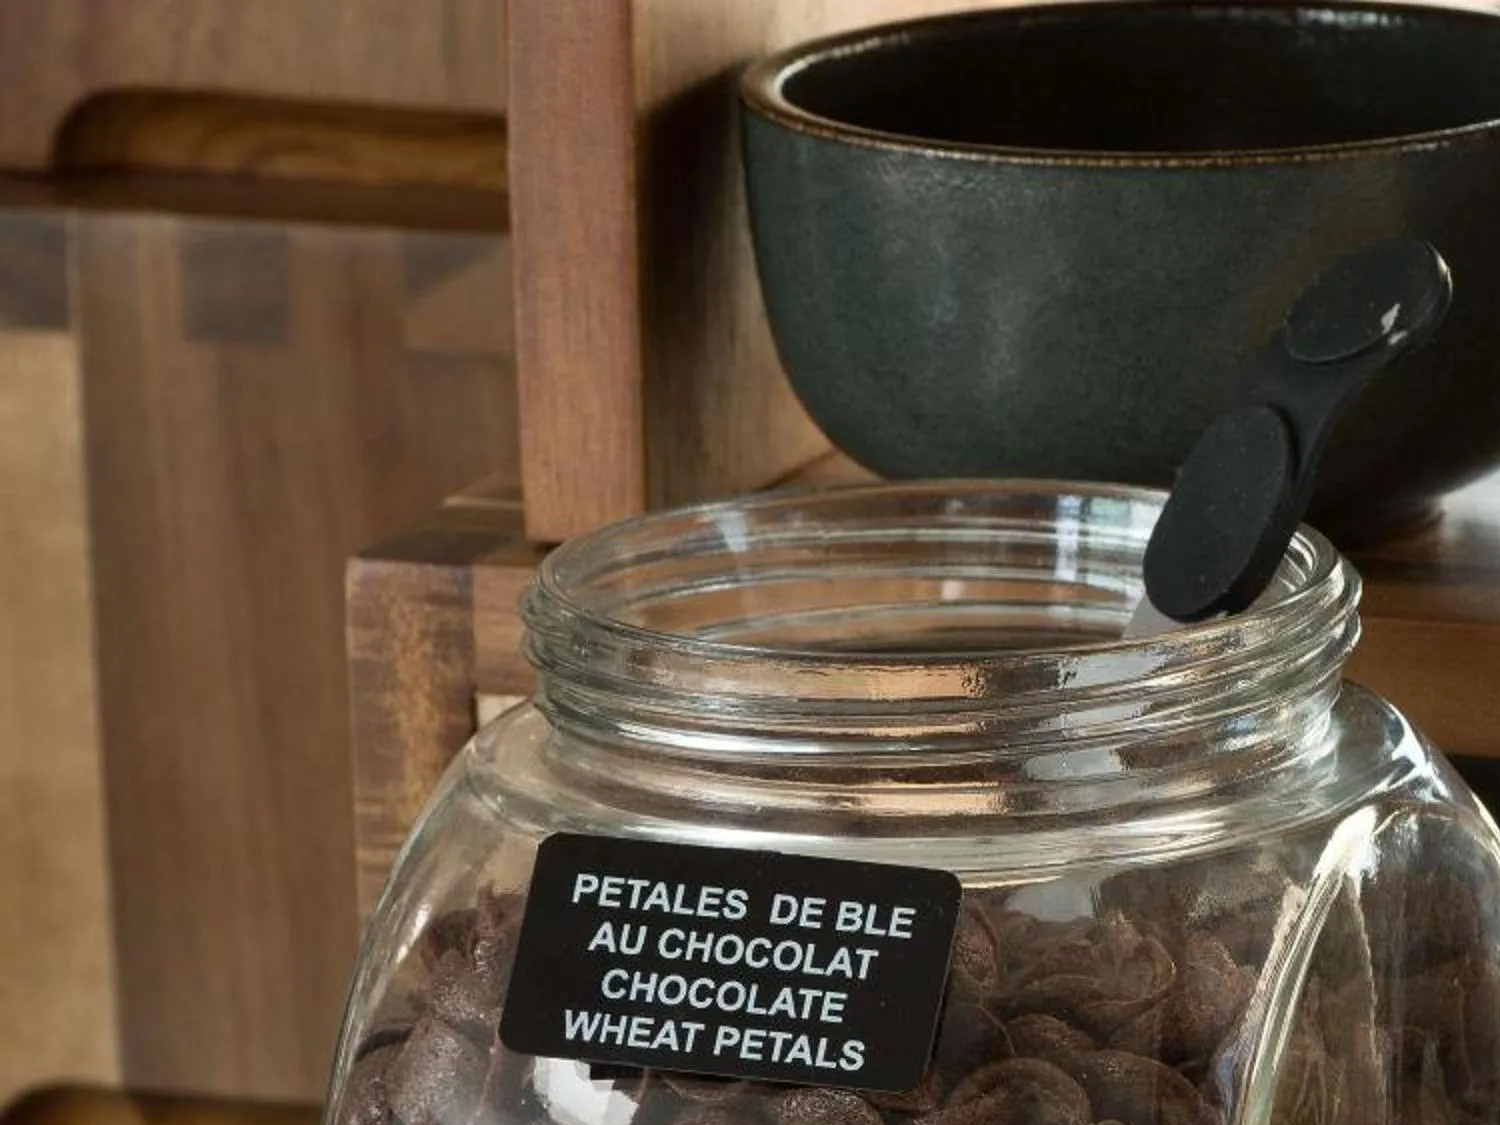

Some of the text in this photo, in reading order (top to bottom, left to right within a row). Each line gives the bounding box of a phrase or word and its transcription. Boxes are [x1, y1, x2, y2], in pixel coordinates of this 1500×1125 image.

[573, 873, 916, 939] PETALES DE BLE
[588, 922, 879, 980] AU CHOCOLAT
[601, 968, 848, 1023] CHOCOLATE
[565, 1009, 865, 1071] WHEAT PETALS
